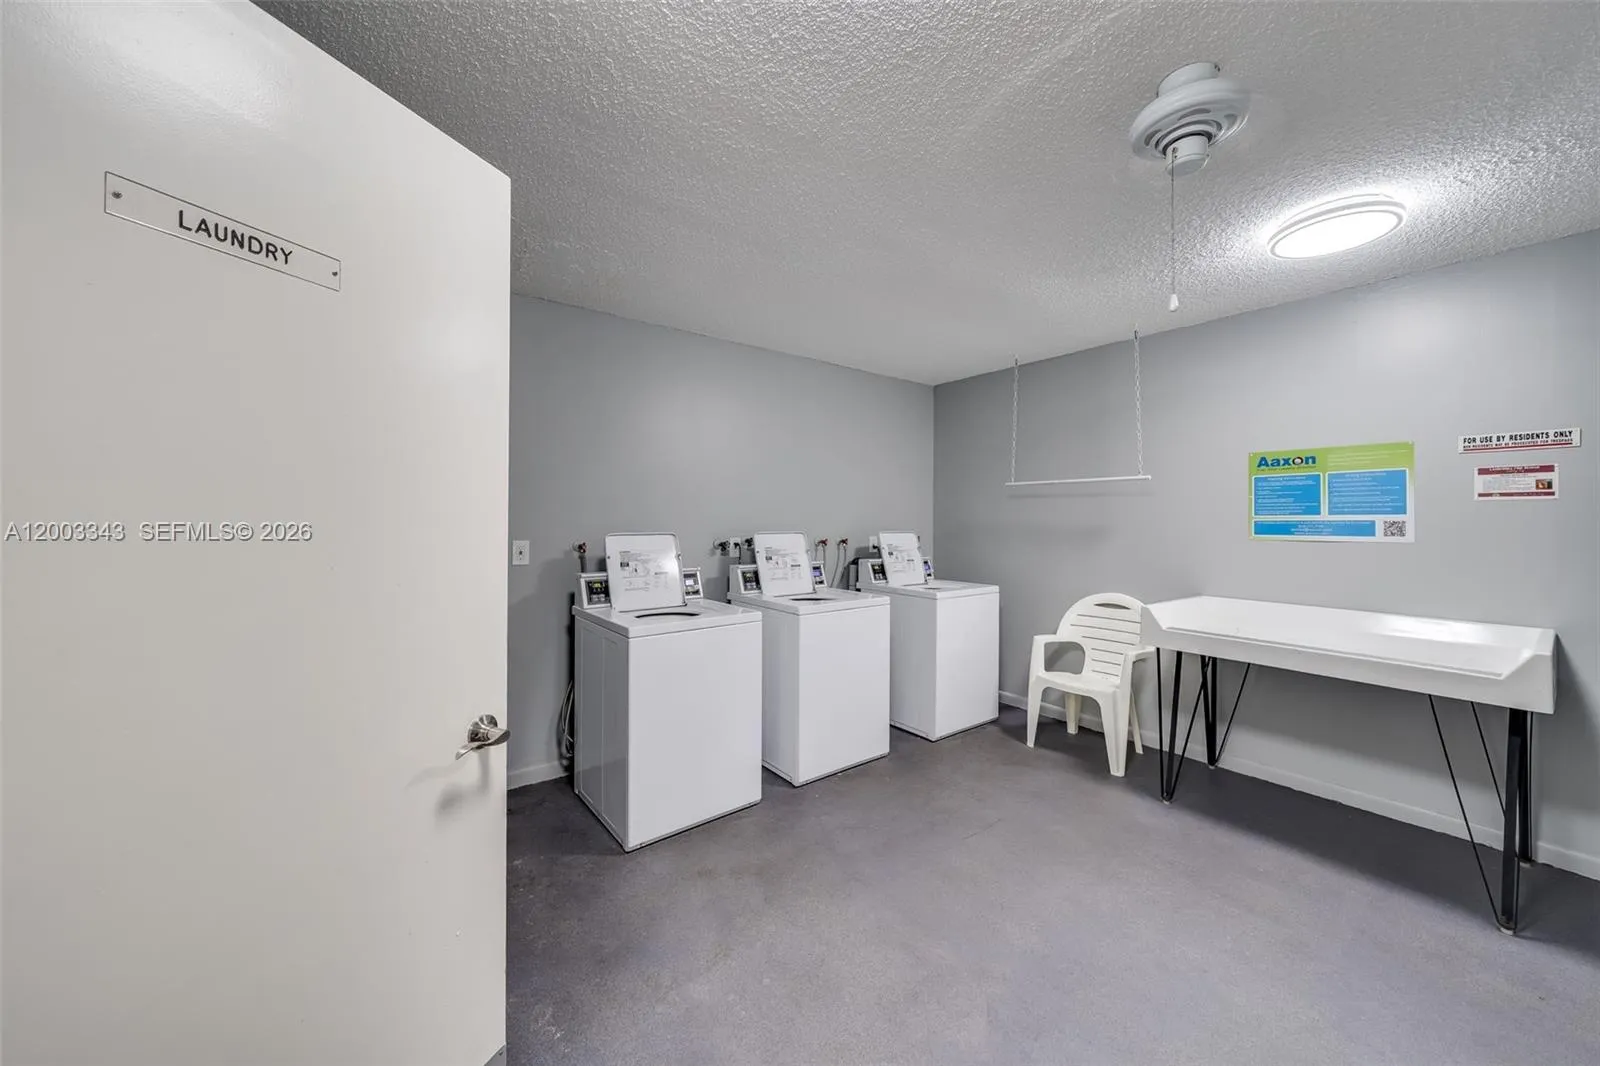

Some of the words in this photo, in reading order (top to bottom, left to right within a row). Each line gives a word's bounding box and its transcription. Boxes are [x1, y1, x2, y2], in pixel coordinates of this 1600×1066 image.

[178, 209, 293, 265] LAUNDRY
[1509, 432, 1550, 441] RESIDENTS
[1553, 430, 1573, 438] ONLY
[1256, 455, 1317, 468] Aaxon
